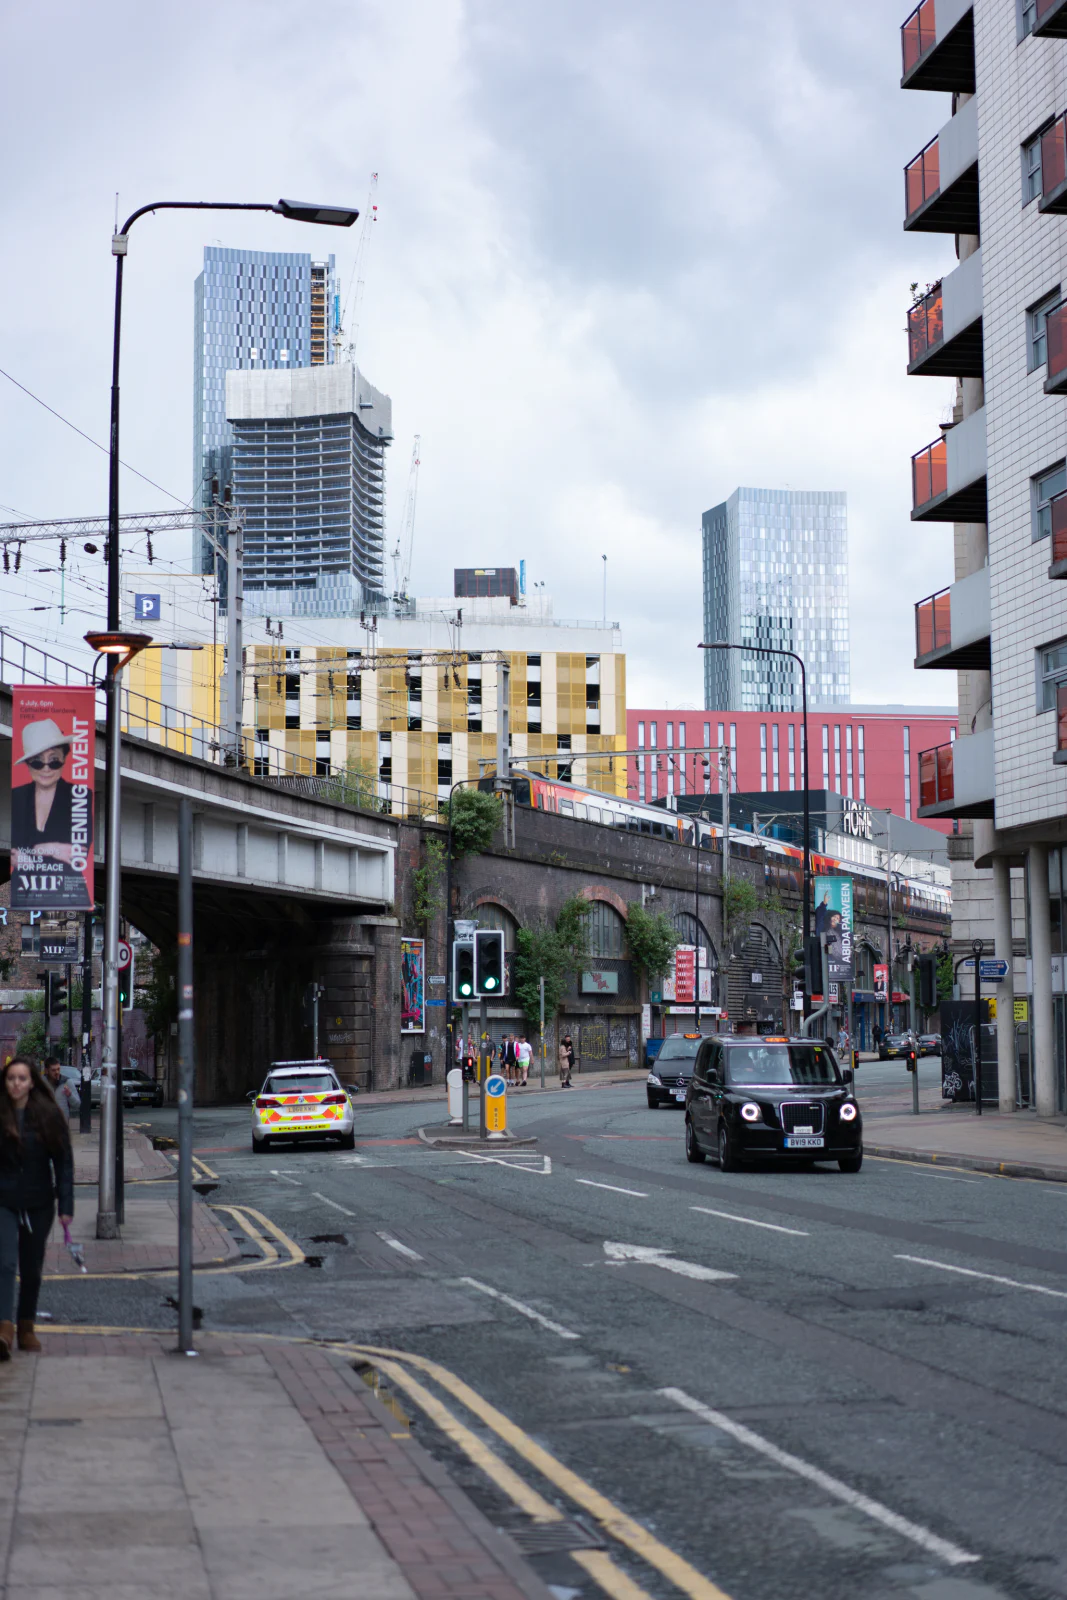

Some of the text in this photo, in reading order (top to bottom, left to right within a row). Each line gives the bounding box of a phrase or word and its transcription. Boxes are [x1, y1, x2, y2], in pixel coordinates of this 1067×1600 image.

[142, 599, 154, 617] P
[72, 716, 89, 780] EVENT
[71, 784, 88, 872] OPENING
[843, 799, 872, 840] HOME
[17, 847, 37, 855] Yoko
[17, 855, 43, 863] BELLS
[17, 863, 63, 871] FOR PEACE
[18, 875, 63, 891] MIF
[841, 883, 850, 931] PARVEEN
[43, 946, 65, 954] MIF
[841, 931, 851, 963] ABIDA
[790, 1138, 806, 1146] BV19
